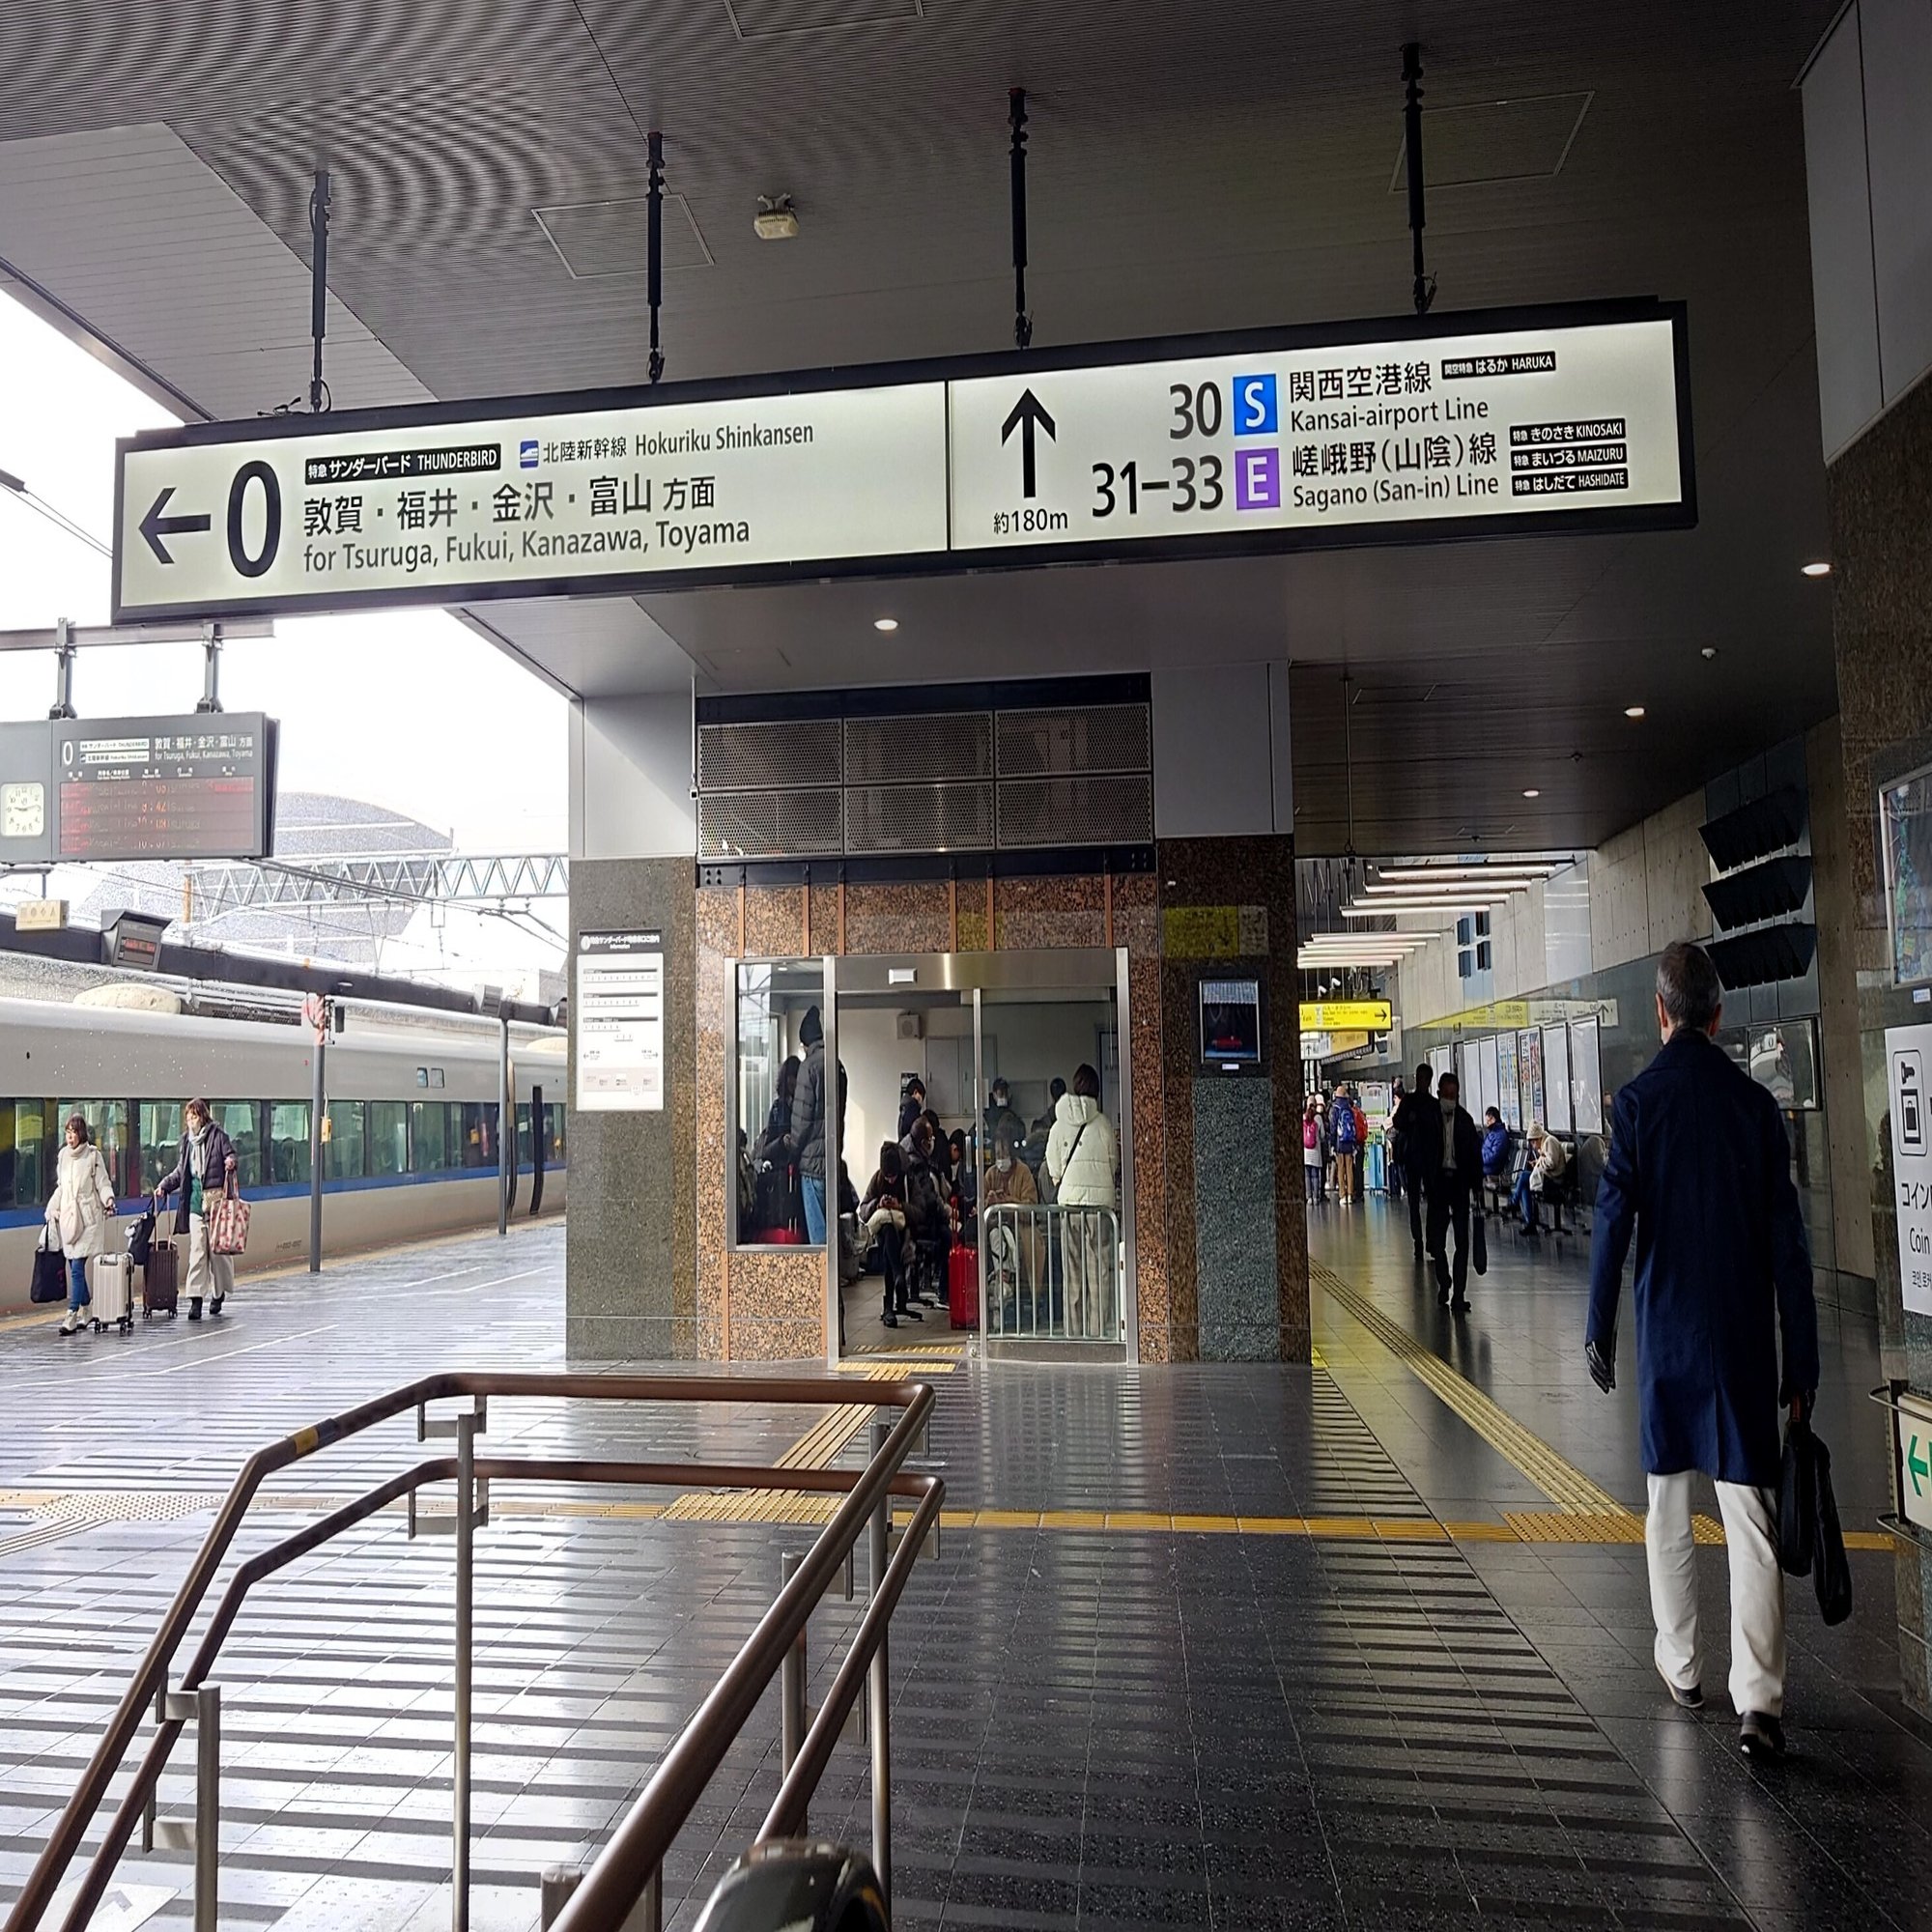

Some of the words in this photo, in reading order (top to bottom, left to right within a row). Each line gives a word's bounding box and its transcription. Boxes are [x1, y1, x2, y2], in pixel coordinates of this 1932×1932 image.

[1290, 360, 1432, 404] 関西空港線
[1475, 357, 1508, 374] はるか
[1512, 355, 1553, 371] HARUKA
[1169, 381, 1222, 440] 30
[1243, 381, 1266, 428] S
[1291, 401, 1438, 433] Kansai-airport
[1445, 397, 1489, 422] Line
[542, 436, 628, 464] 北陸新幹線
[635, 428, 711, 457] Hokuriku
[716, 421, 814, 450] Shinkansen
[1513, 430, 1528, 442] 特急
[1530, 425, 1575, 442] きのさき
[1576, 422, 1623, 439] KINOSAKI
[308, 464, 327, 479] 特急
[328, 454, 412, 479] サンダーバード
[417, 449, 497, 471] THUNDERBIRD
[1293, 432, 1497, 477] 嵯峨野（山陰）線
[1514, 454, 1529, 467] 特急
[1531, 449, 1576, 467] まいづる
[1577, 447, 1623, 463] MAIZURU
[662, 475, 716, 512] 方面
[1091, 454, 1224, 518] 31-33
[1246, 456, 1269, 502] E
[1293, 485, 1367, 512] Sagano
[1374, 474, 1449, 504] (San-in)
[1457, 472, 1498, 497] Line
[1515, 479, 1530, 492] 特急
[1532, 474, 1576, 492] はしだて
[1577, 472, 1625, 488] HASHIDATE
[226, 459, 282, 578] 0
[993, 508, 1068, 535] 約180m
[304, 543, 337, 573] for
[342, 541, 439, 573] Tsuruga,
[445, 531, 514, 563] Fukui,
[522, 526, 650, 558] Kanazawa,
[655, 518, 751, 554] Toyama
[1901, 1181, 1932, 1210] コイン
[1909, 1227, 1931, 1255] Coin
